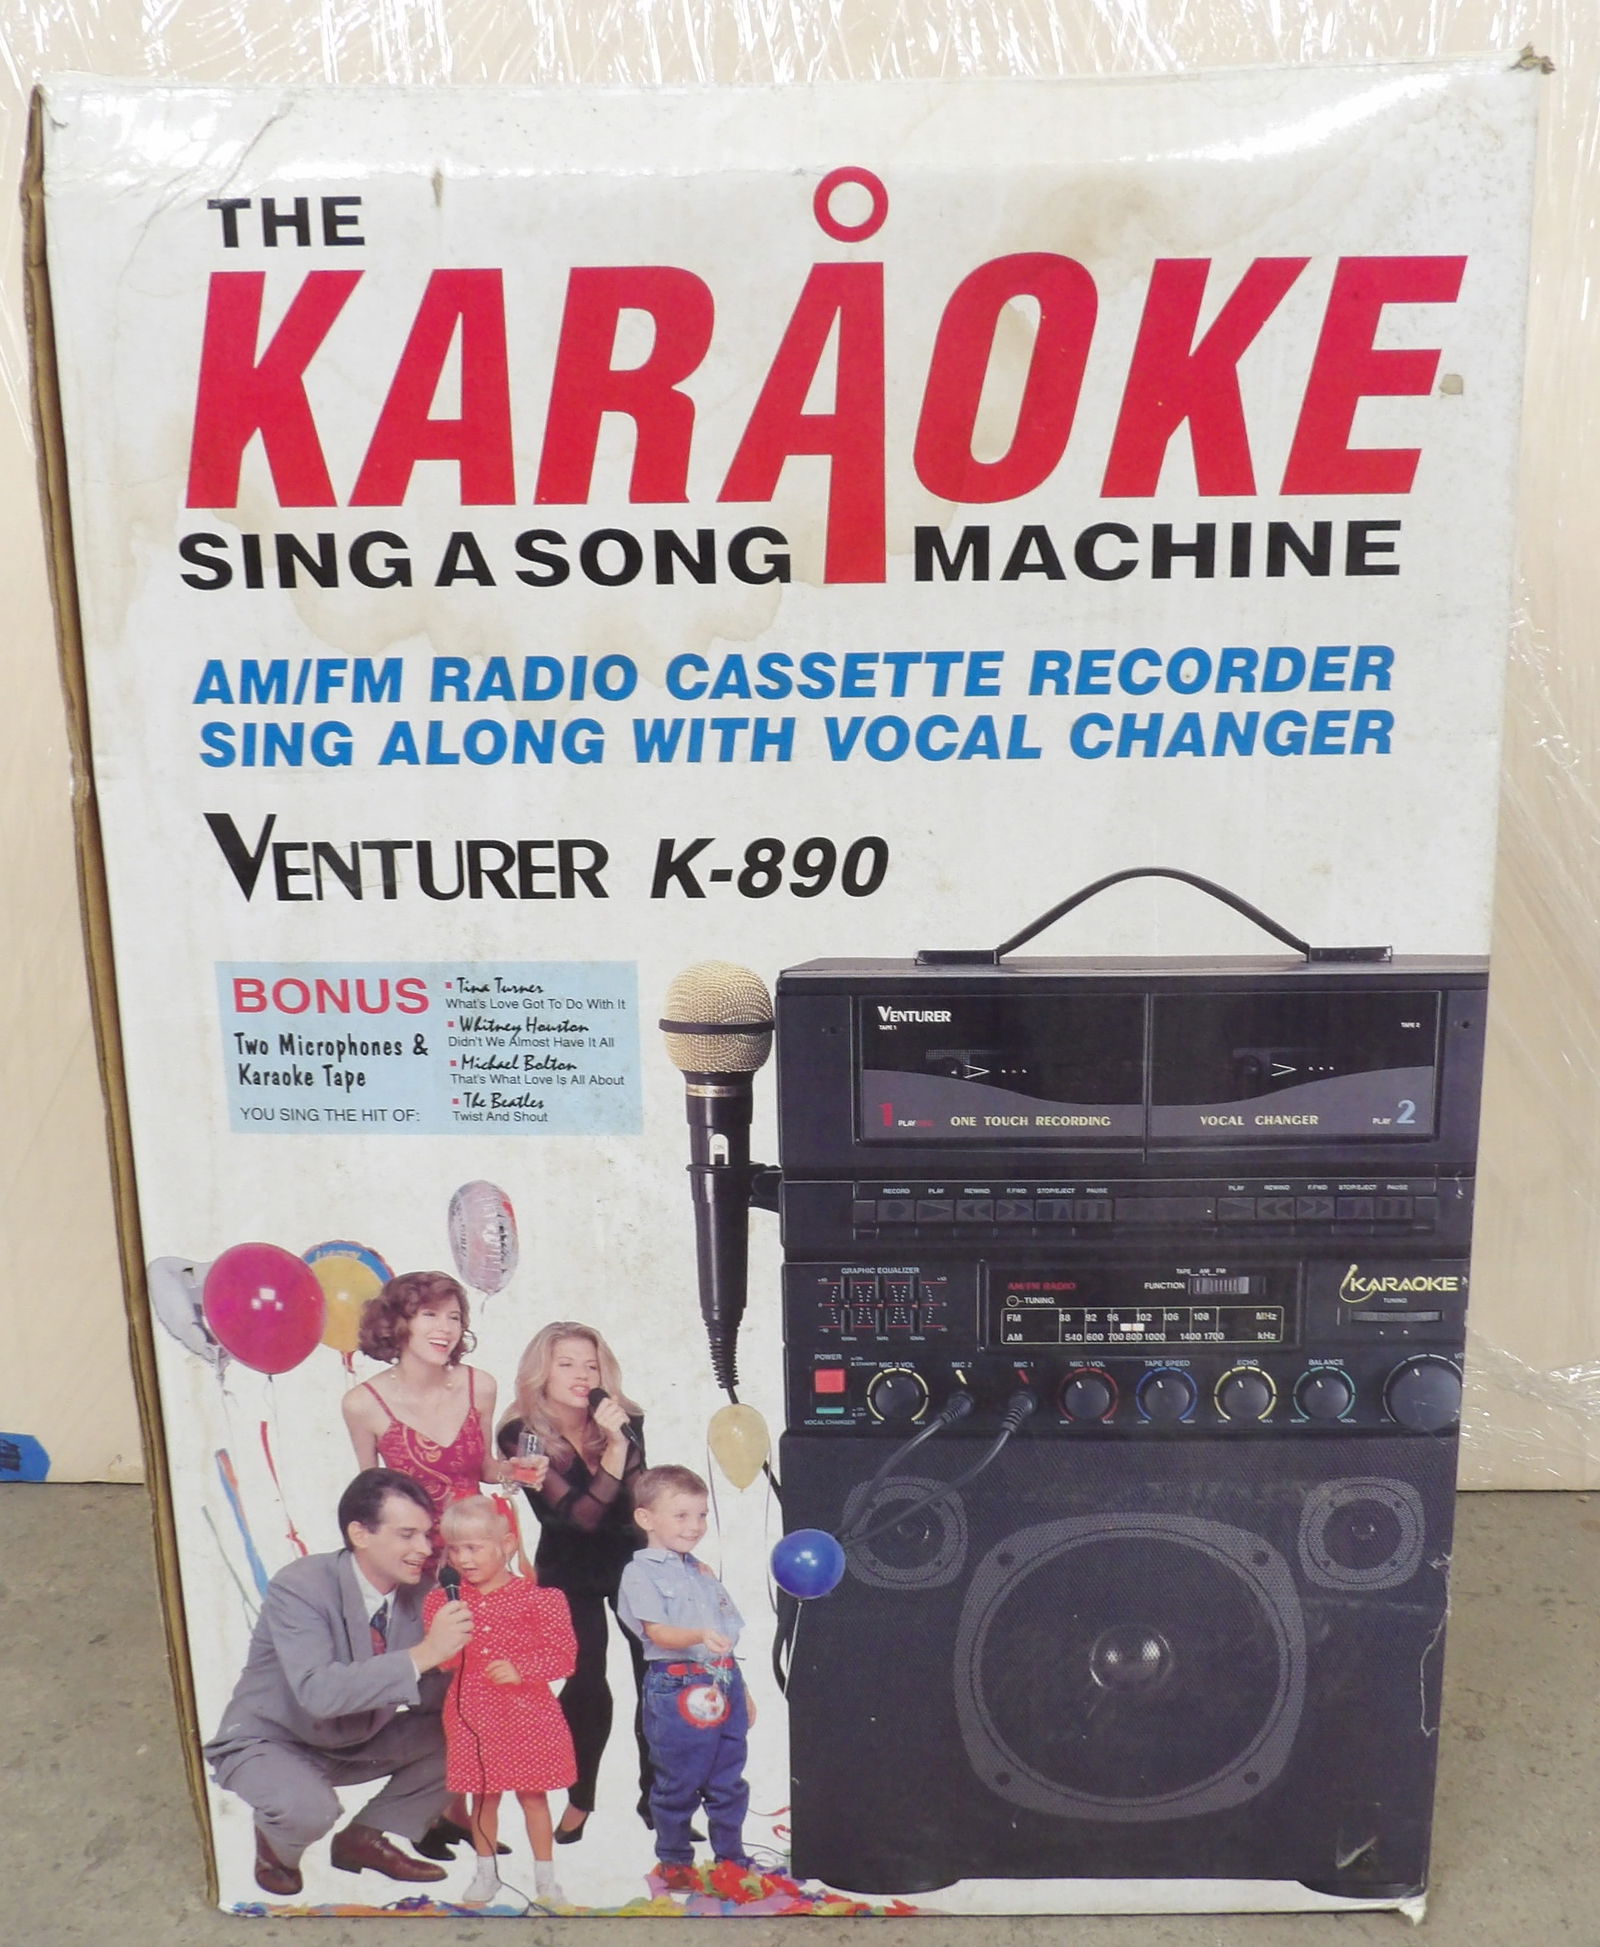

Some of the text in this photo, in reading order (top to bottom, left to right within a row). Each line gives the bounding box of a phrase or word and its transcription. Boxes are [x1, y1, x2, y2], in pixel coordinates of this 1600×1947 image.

[207, 195, 366, 249] THE
[186, 251, 1468, 585] KARAOKE
[914, 519, 1402, 582] MACHINE
[178, 525, 792, 591] SING A SONG
[191, 645, 1395, 706] AM/FM RADIO CASSETTE RECORDER
[200, 709, 1395, 768] SING ALONG WITH VOCAL CHANGER
[202, 812, 890, 903] VENTURER K-890
[456, 976, 545, 994] Tina Turner
[232, 977, 430, 1015] BONUS
[445, 998, 626, 1011] What's Love Got To Do With It
[877, 1005, 952, 1023] VENTURER
[458, 1014, 590, 1040] Whitney Houston
[233, 1031, 429, 1063] Two Microphones &
[447, 1036, 615, 1048] Didn't We Almost Have It All
[461, 1053, 578, 1072] Michael Bolton
[237, 1062, 367, 1094] Karaoke Tape
[449, 1073, 625, 1086] That's What Love Is All About
[463, 1091, 545, 1110] The Beatles
[239, 1107, 421, 1122] YOU SING THE HIT OF:
[452, 1110, 548, 1123] Twist And Shout
[879, 1102, 894, 1127] 1
[897, 1119, 917, 1128] PLAY
[1372, 1099, 1416, 1126] PLAY 2
[950, 1116, 977, 1127] ONE
[984, 1115, 1029, 1127] TOUCH
[1035, 1115, 1112, 1127] RECORDING
[1199, 1114, 1319, 1126] VOCAL CHANGER
[882, 1187, 911, 1195] RECORD
[927, 1187, 945, 1195] PLAY
[840, 1266, 921, 1275] GRAPHIC EQUALIZER
[1043, 1281, 1077, 1291] RADIO
[1143, 1280, 1186, 1290] FUNCTION
[1349, 1275, 1460, 1293] KARAOKE
[1023, 1296, 1055, 1305] TUNING
[1006, 1313, 1022, 1323] FM
[1084, 1313, 1098, 1323] 92
[1135, 1312, 1153, 1322] 102
[1163, 1312, 1180, 1322] 106
[1193, 1312, 1210, 1321] 108
[1255, 1311, 1278, 1321] MHz
[1006, 1330, 1277, 1342] AM 540 600 700 800 1000 1400 1700 kHz
[814, 1353, 843, 1361] POWER
[1165, 1359, 1191, 1367] SPEED
[1236, 1359, 1260, 1367] ECHO
[1308, 1358, 1345, 1366] BALANCE
[878, 1361, 894, 1369] MIC
[900, 1361, 916, 1369] VOL
